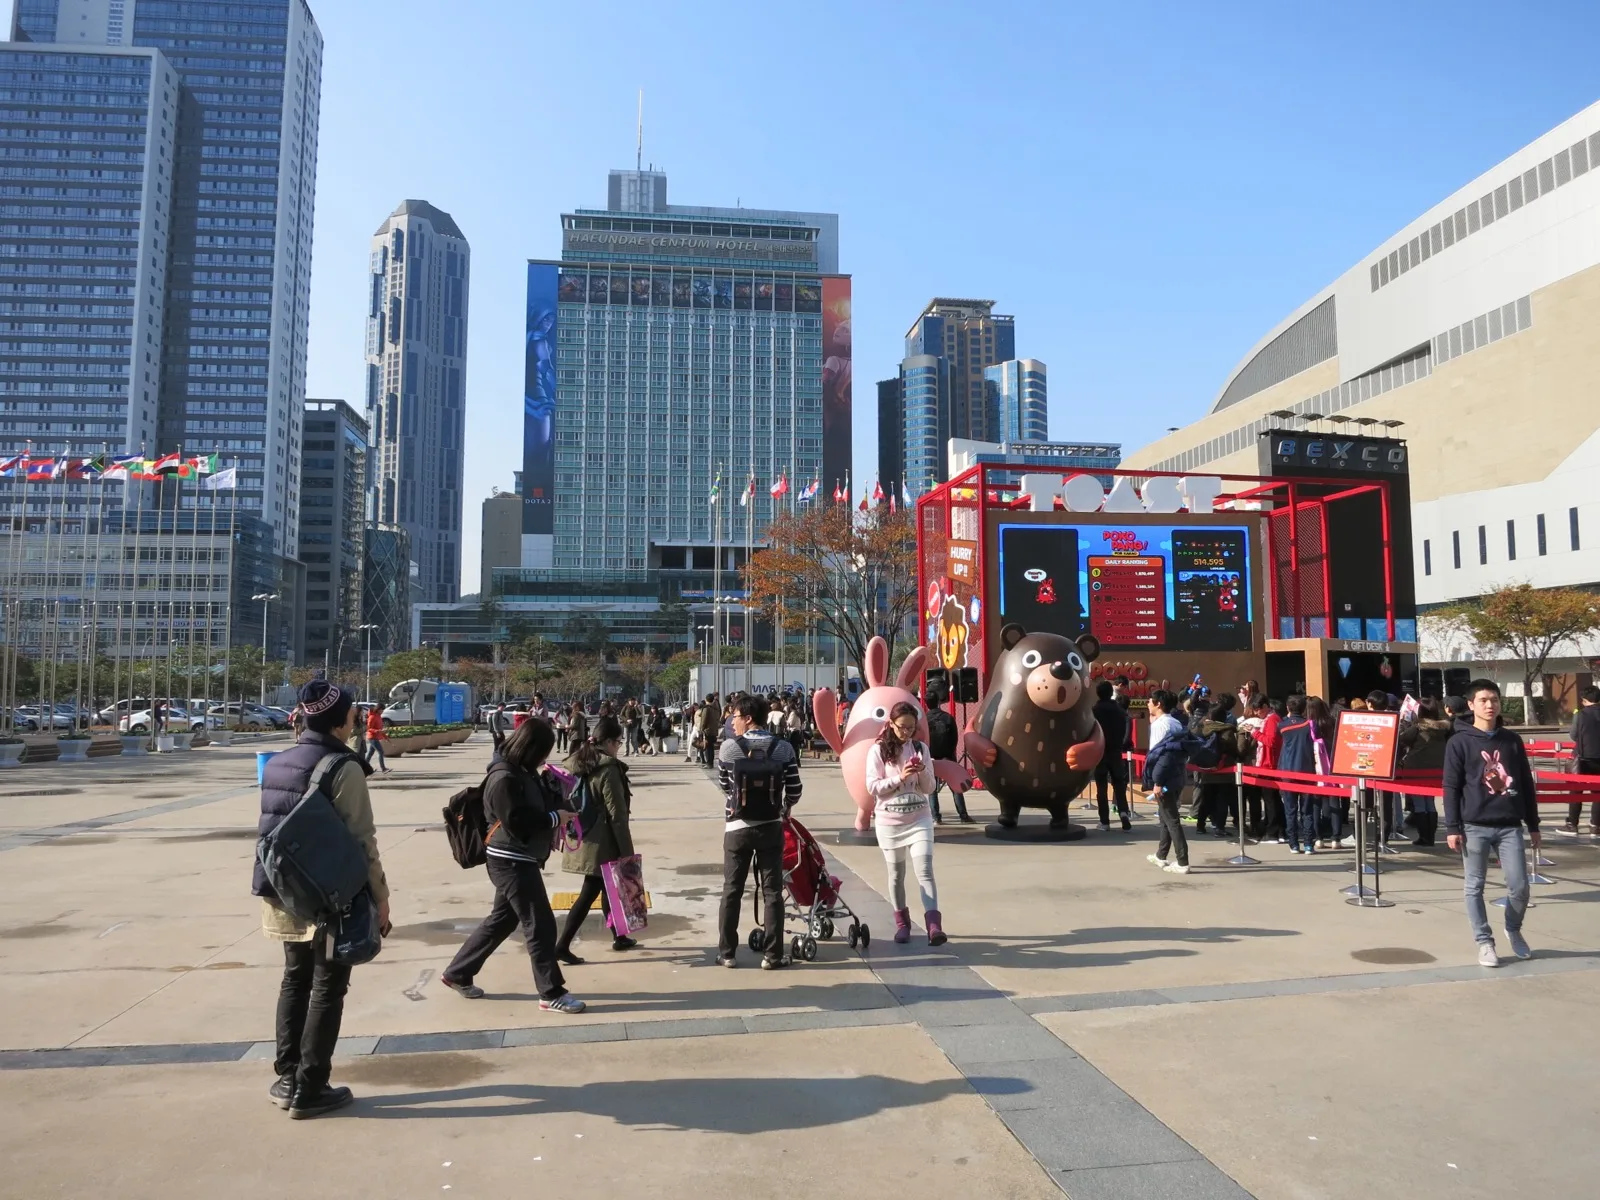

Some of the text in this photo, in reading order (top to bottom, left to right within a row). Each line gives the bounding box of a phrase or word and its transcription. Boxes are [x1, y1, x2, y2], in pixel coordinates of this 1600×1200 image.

[569, 233, 645, 246] HAEUNDAE
[651, 237, 710, 249] CENTUM
[715, 240, 760, 251] HOTEL
[1277, 439, 1406, 463] BEXCO
[1020, 473, 1222, 513] TOAST
[1103, 530, 1136, 541] POKO
[950, 546, 973, 561] HURRY
[1111, 540, 1149, 551] PANG!
[1350, 641, 1383, 651] GIFT DESK
[1088, 661, 1148, 681] POKO
